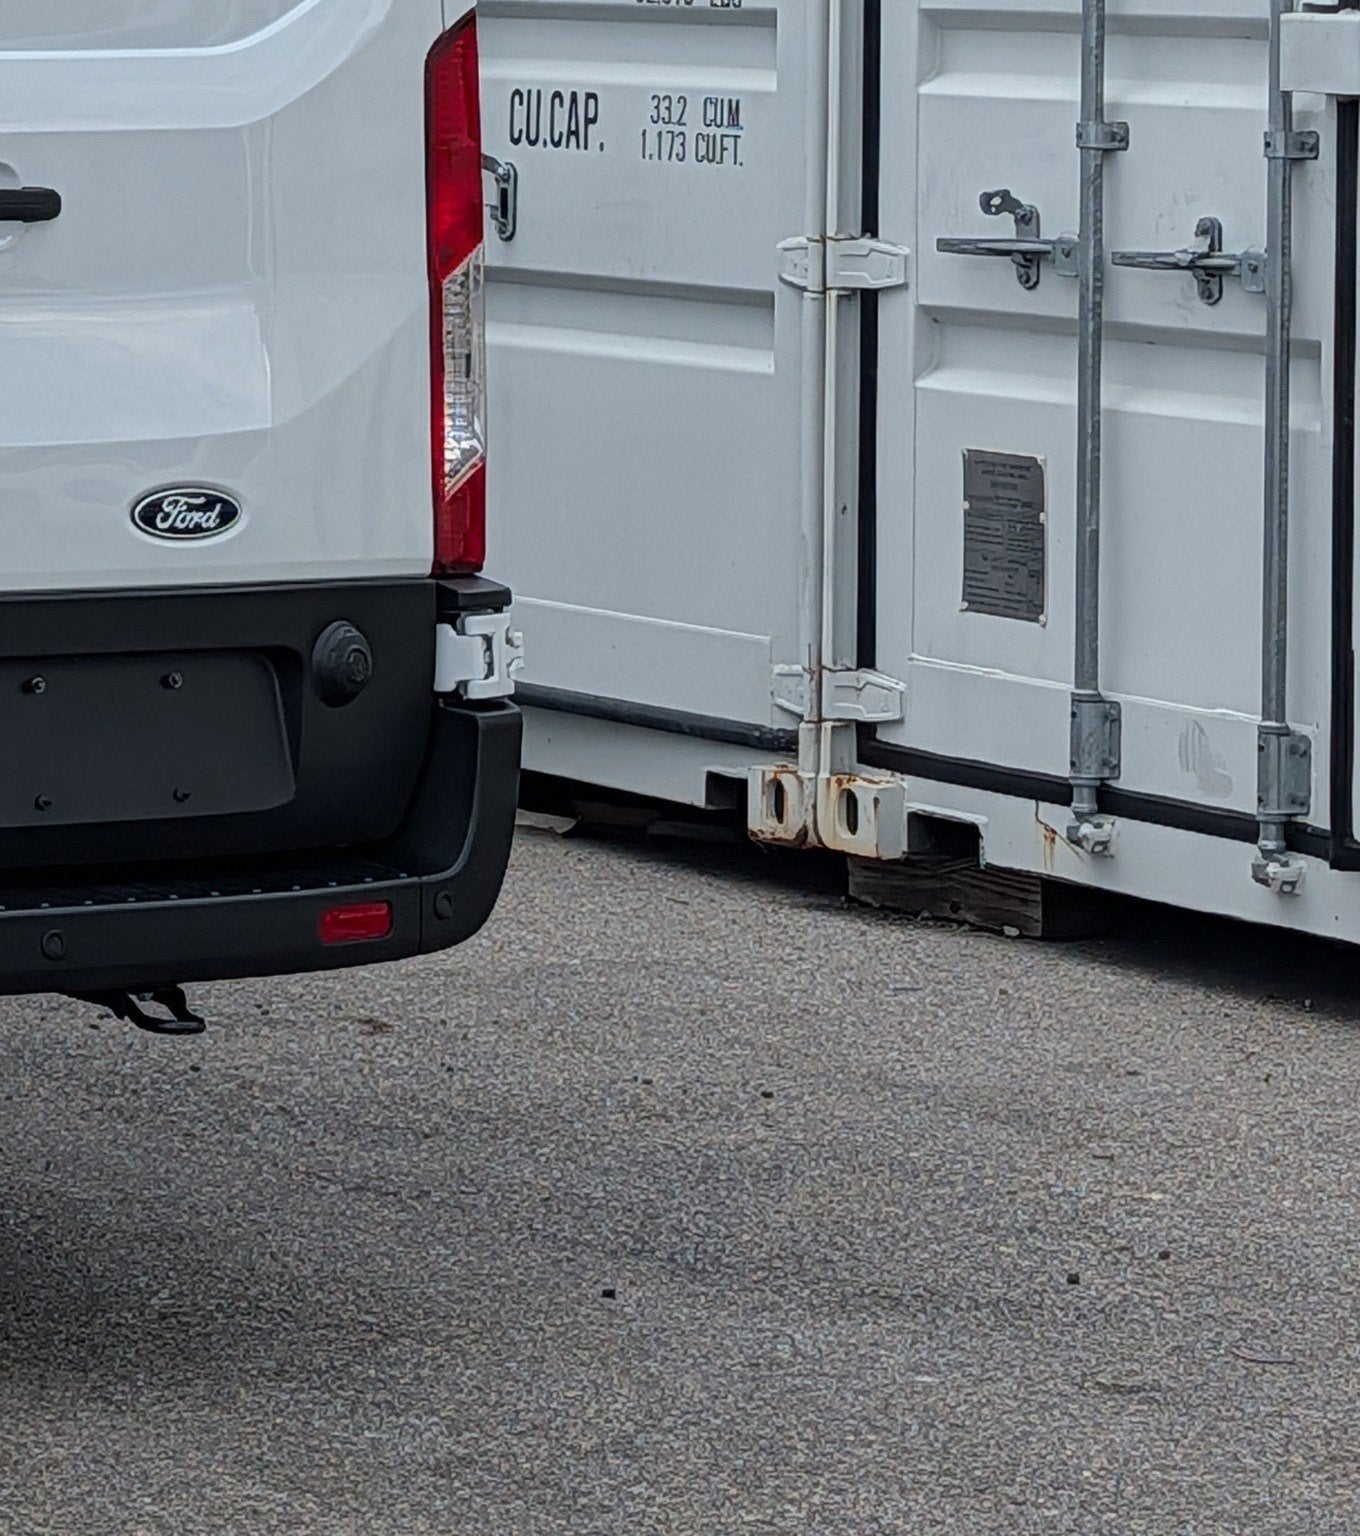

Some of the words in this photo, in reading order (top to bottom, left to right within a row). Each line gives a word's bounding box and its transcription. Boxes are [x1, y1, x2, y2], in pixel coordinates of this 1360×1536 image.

[509, 87, 605, 153] CU.CAP.
[641, 128, 687, 162] 1.173
[155, 495, 223, 530] Ford
